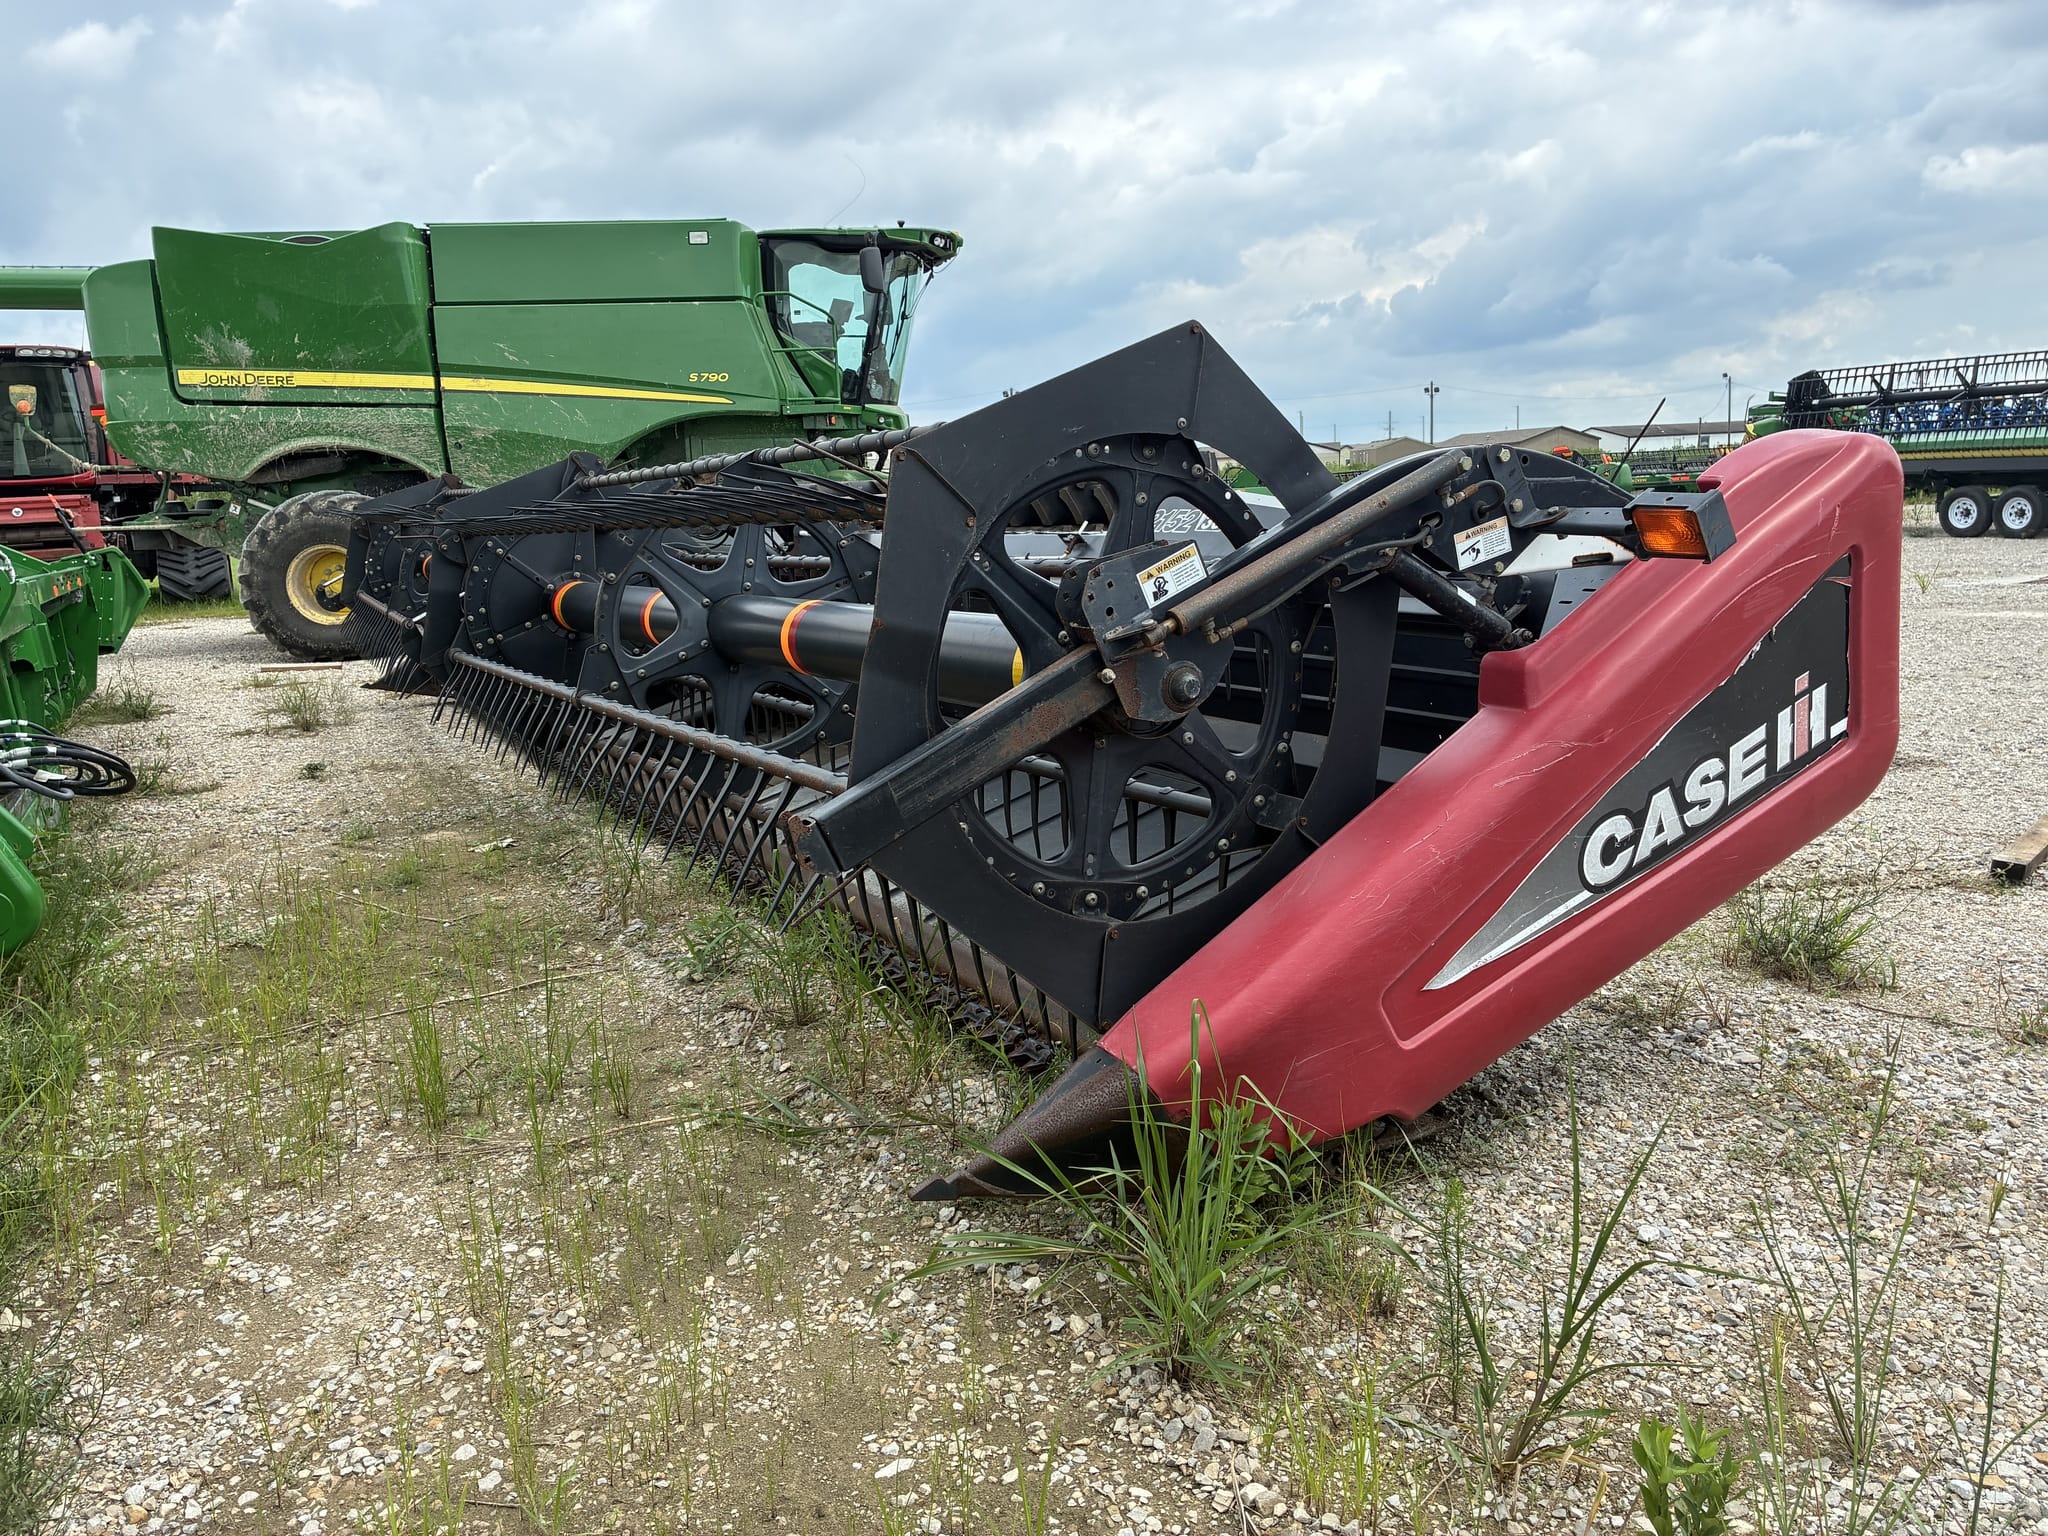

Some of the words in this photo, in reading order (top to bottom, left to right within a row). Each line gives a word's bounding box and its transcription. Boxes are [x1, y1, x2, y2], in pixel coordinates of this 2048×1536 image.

[200, 372, 241, 385] JOHN
[244, 373, 296, 386] DEERE
[1470, 522, 1498, 537] WARNING
[1155, 550, 1192, 575] WARNING
[1582, 722, 1767, 887] CASE
